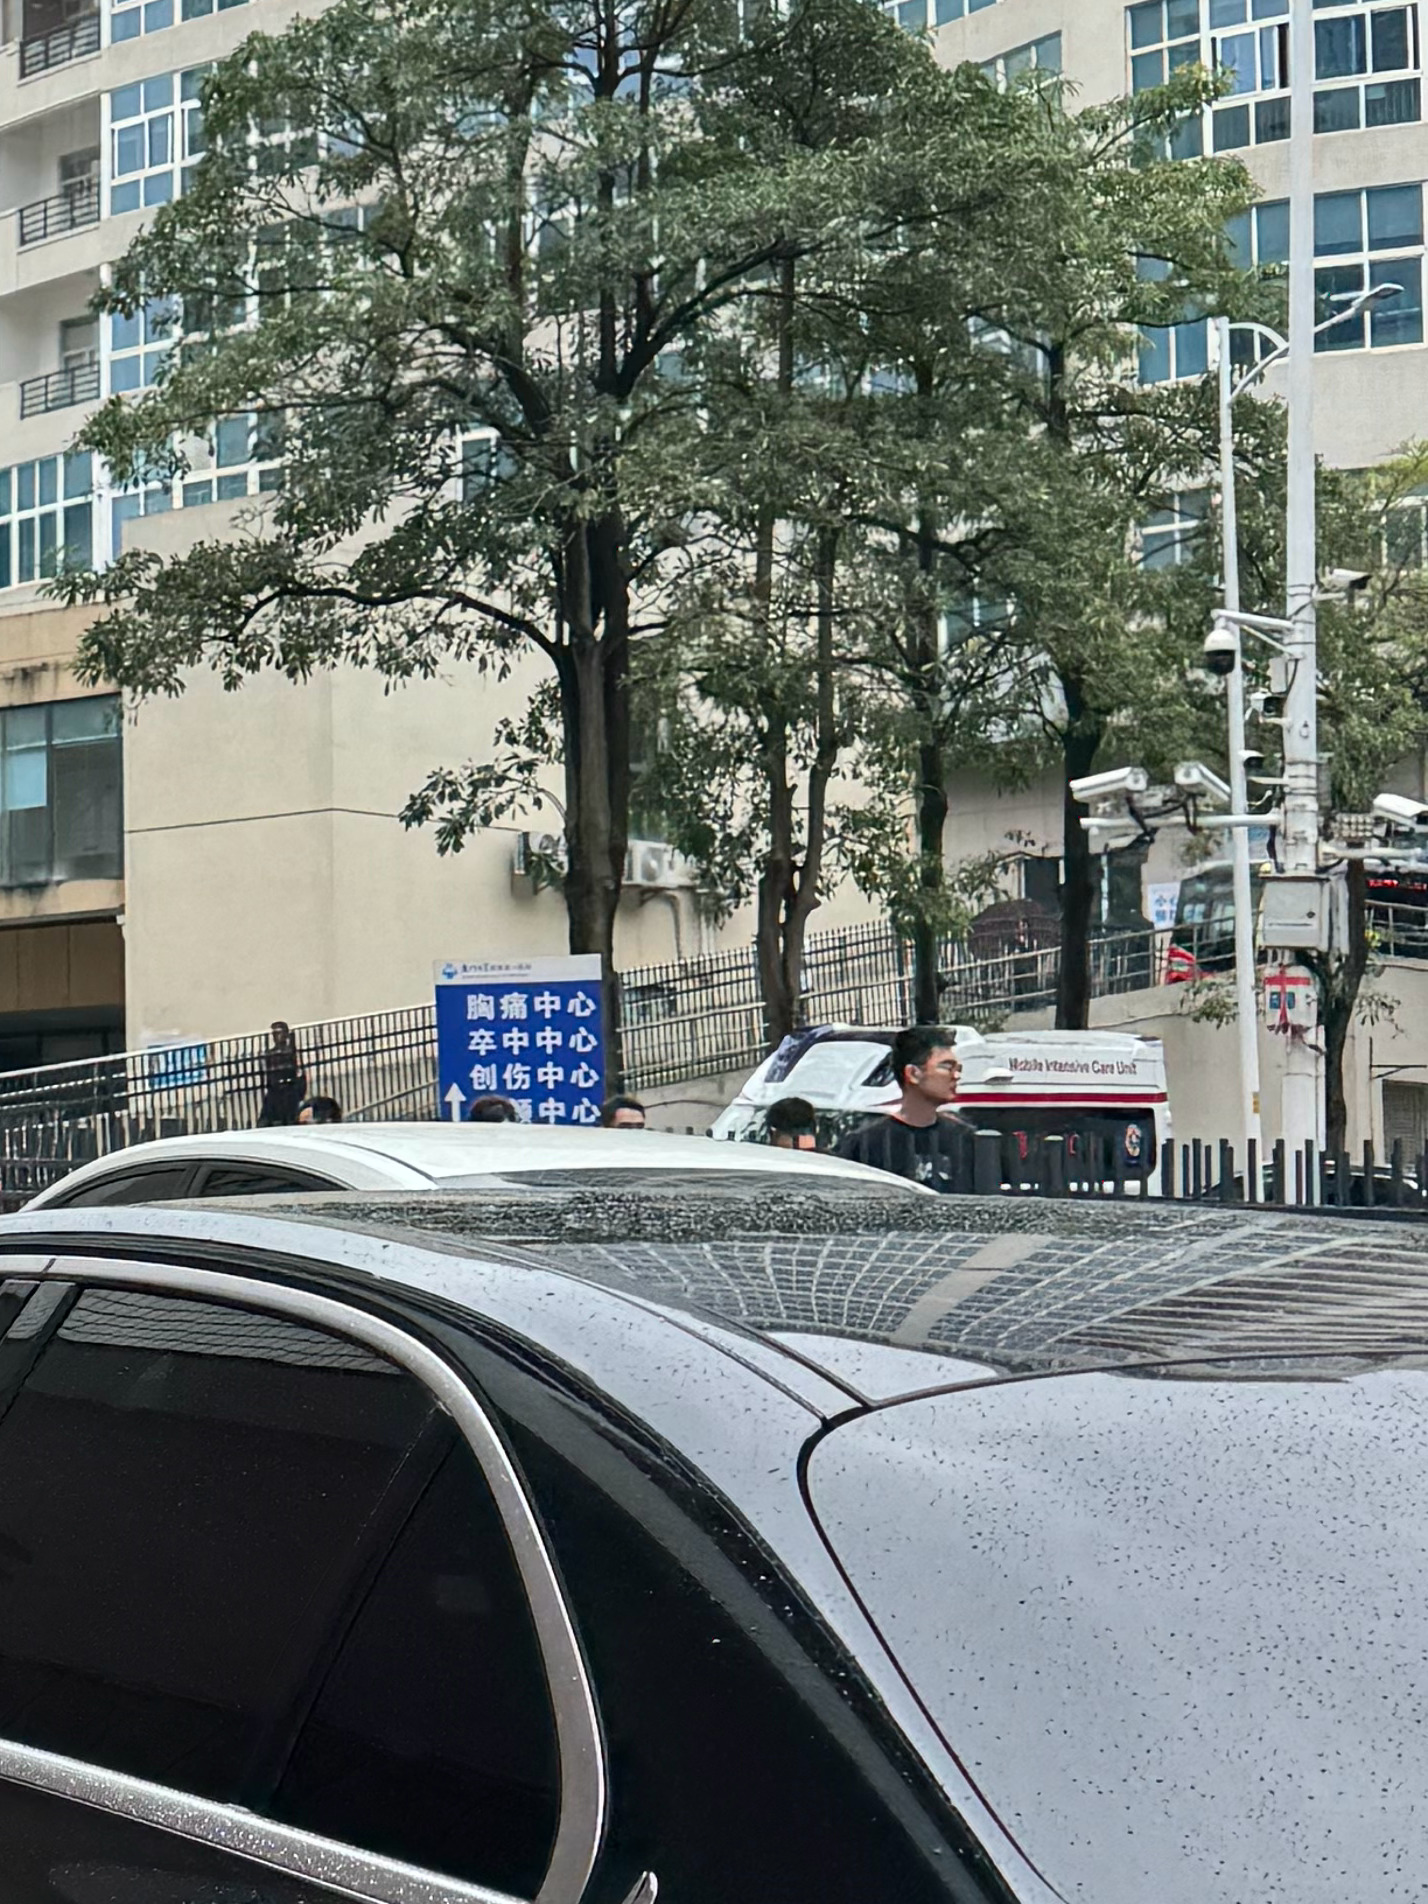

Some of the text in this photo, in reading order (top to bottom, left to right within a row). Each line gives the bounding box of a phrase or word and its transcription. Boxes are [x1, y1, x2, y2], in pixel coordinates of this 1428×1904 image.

[466, 990, 597, 1021] 胸痛中心
[468, 1026, 598, 1056] 卒中中心
[469, 1061, 600, 1091] 创伤中心
[1091, 1059, 1115, 1075] Care
[1115, 1060, 1138, 1076] Unit
